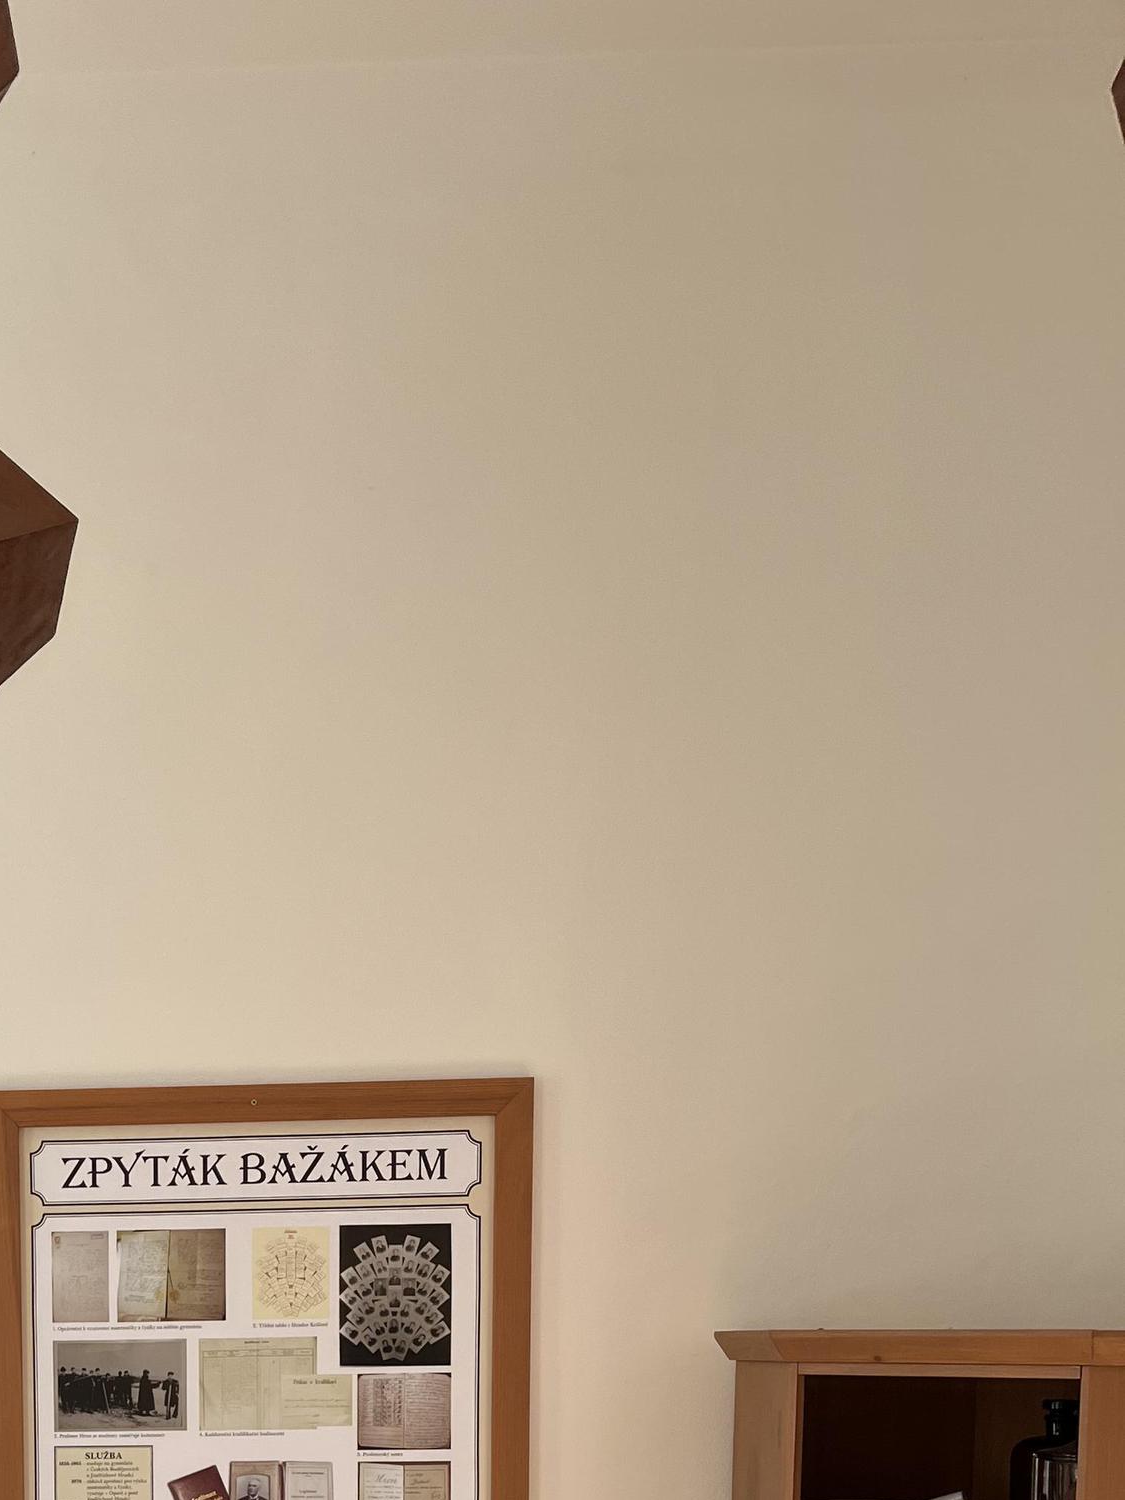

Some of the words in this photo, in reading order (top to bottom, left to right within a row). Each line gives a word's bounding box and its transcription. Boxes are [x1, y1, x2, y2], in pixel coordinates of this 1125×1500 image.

[61, 1148, 228, 1189] ZPYTÁK
[239, 1144, 449, 1185] BAŽÁKEM
[85, 1450, 123, 1460] SLUŽBA
